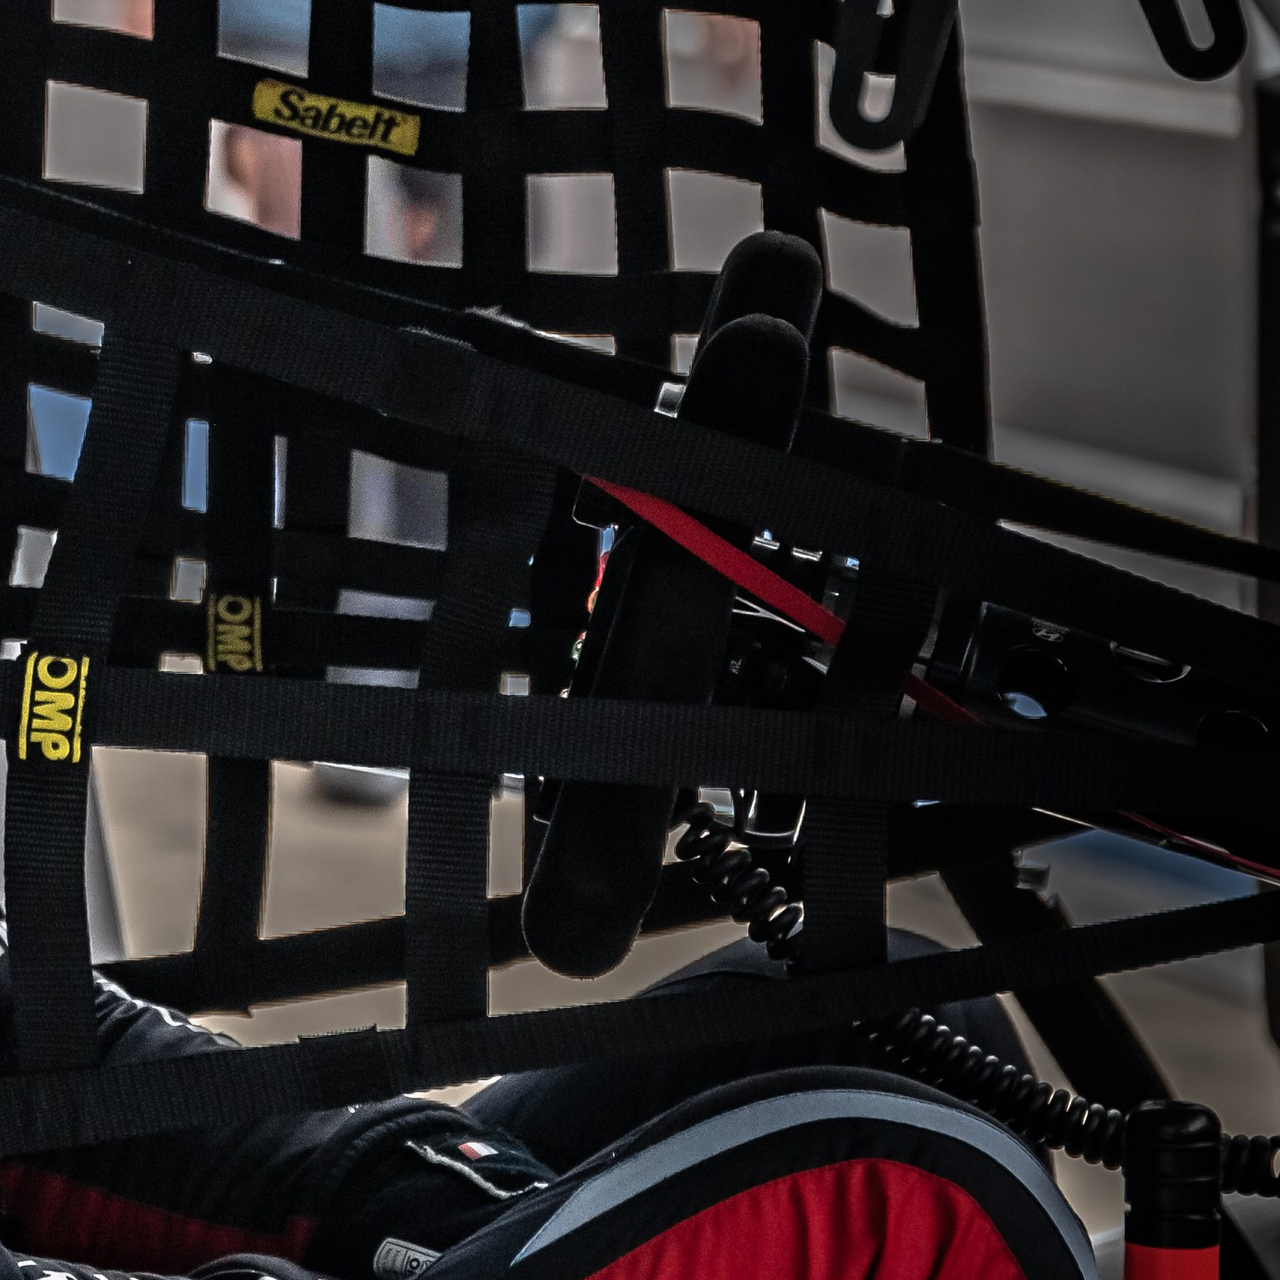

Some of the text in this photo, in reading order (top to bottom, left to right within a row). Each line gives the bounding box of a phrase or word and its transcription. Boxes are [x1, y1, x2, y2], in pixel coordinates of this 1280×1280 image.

[273, 88, 401, 144] Sabelt
[215, 594, 255, 672] OMP
[28, 654, 80, 762] OMP
